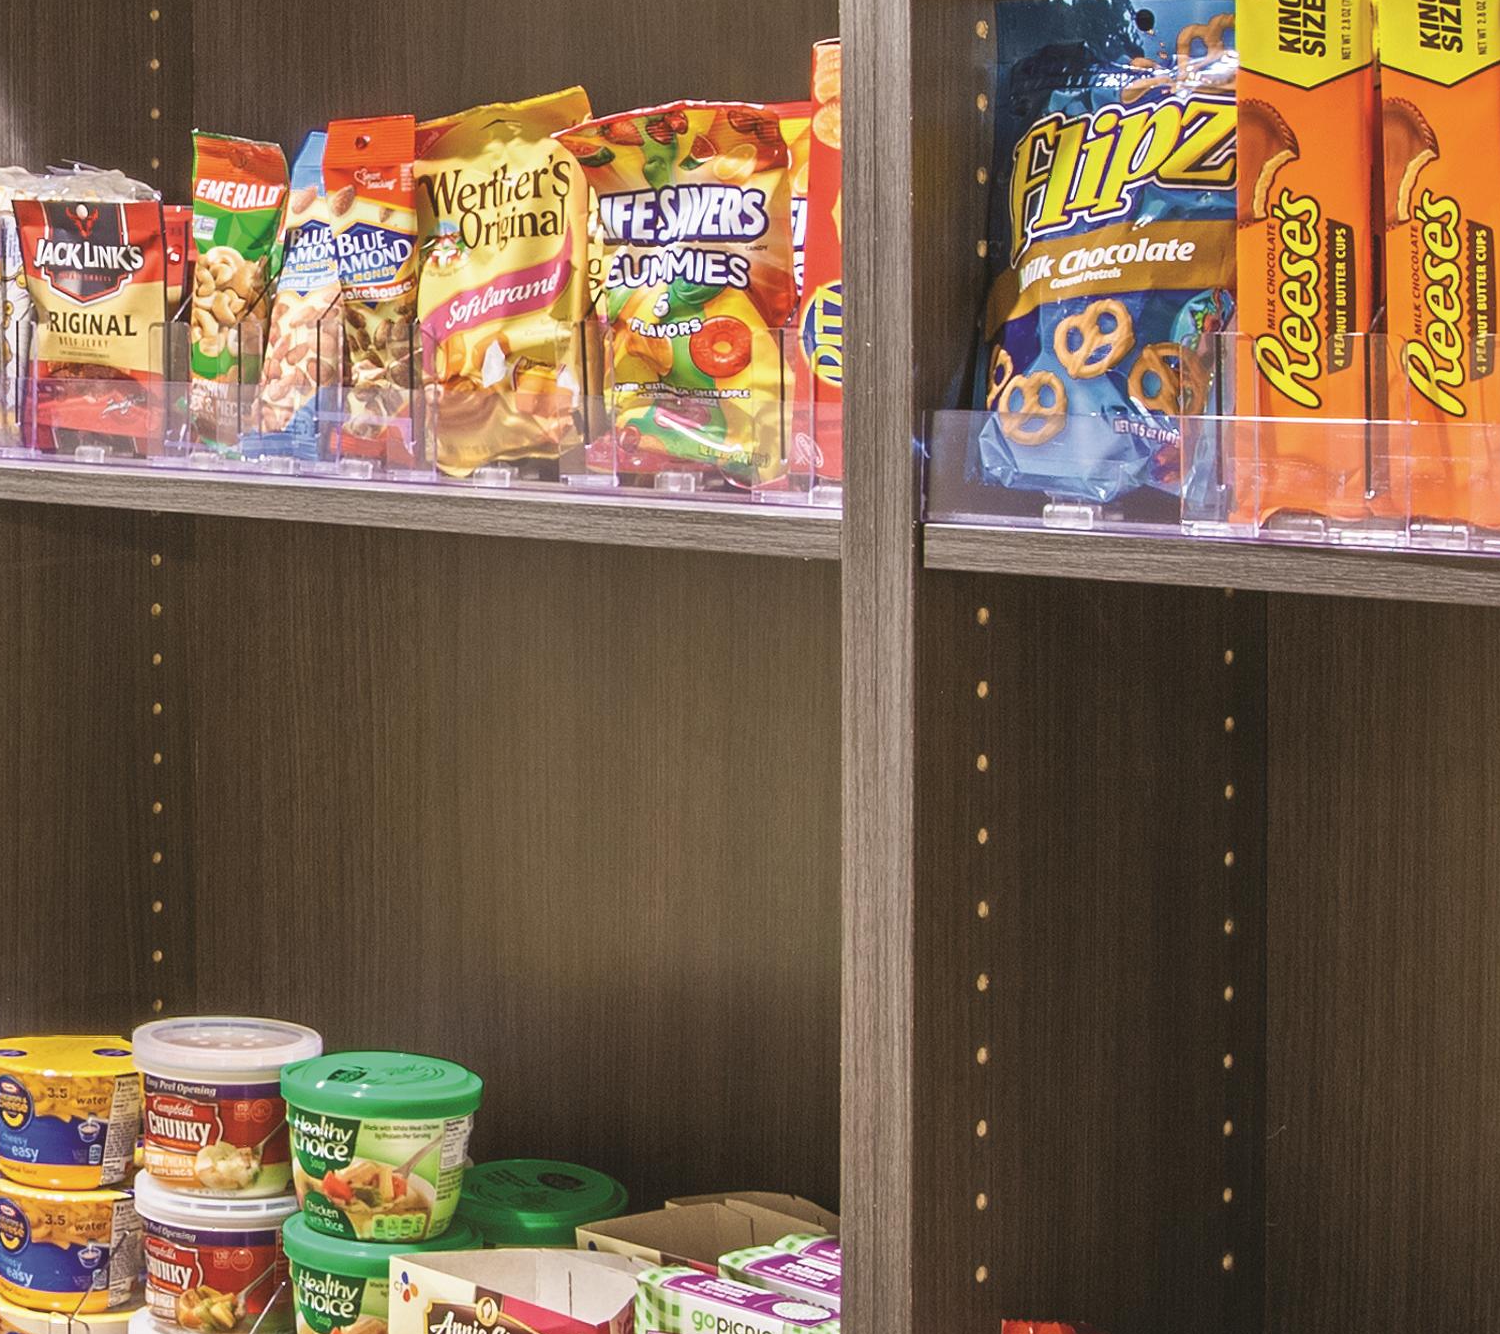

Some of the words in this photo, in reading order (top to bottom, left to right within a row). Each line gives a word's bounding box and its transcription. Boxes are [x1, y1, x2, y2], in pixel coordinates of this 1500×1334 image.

[195, 179, 281, 208] EMERALD
[427, 153, 573, 220] Werther's
[1011, 97, 1239, 267] Flipz
[458, 193, 566, 250] Original
[660, 187, 766, 239] SAVERS
[34, 240, 83, 269] JACK
[84, 243, 144, 271] LINK'S
[337, 231, 388, 257] BLUE
[1053, 236, 1196, 275] Chocolate
[1335, 227, 1346, 258] CUPS
[606, 250, 748, 287] GUMMIES
[1267, 222, 1276, 295] CHOCOLATE
[1410, 224, 1422, 298] CHOCOLATE
[1335, 262, 1346, 306] BUTTER
[653, 292, 670, 317] 5
[1256, 191, 1321, 410] Reese's
[1268, 298, 1276, 330] MILK
[1404, 191, 1468, 418] Reese's
[632, 319, 702, 338] FLAVORS
[1334, 309, 1346, 356] PEANUT
[47, 1087, 68, 1099] 3.5
[76, 1096, 107, 1105] water
[177, 1083, 216, 1097] Opening
[148, 1111, 211, 1146] CHUNKY
[294, 1114, 354, 1144] Healthy
[11, 1145, 39, 1162] easy
[294, 1135, 349, 1162] Choice
[45, 1214, 66, 1226] 3.5
[74, 1222, 107, 1232] water
[6, 1267, 34, 1286] easy
[299, 1269, 359, 1301] Healthy
[298, 1290, 354, 1317] Choice
